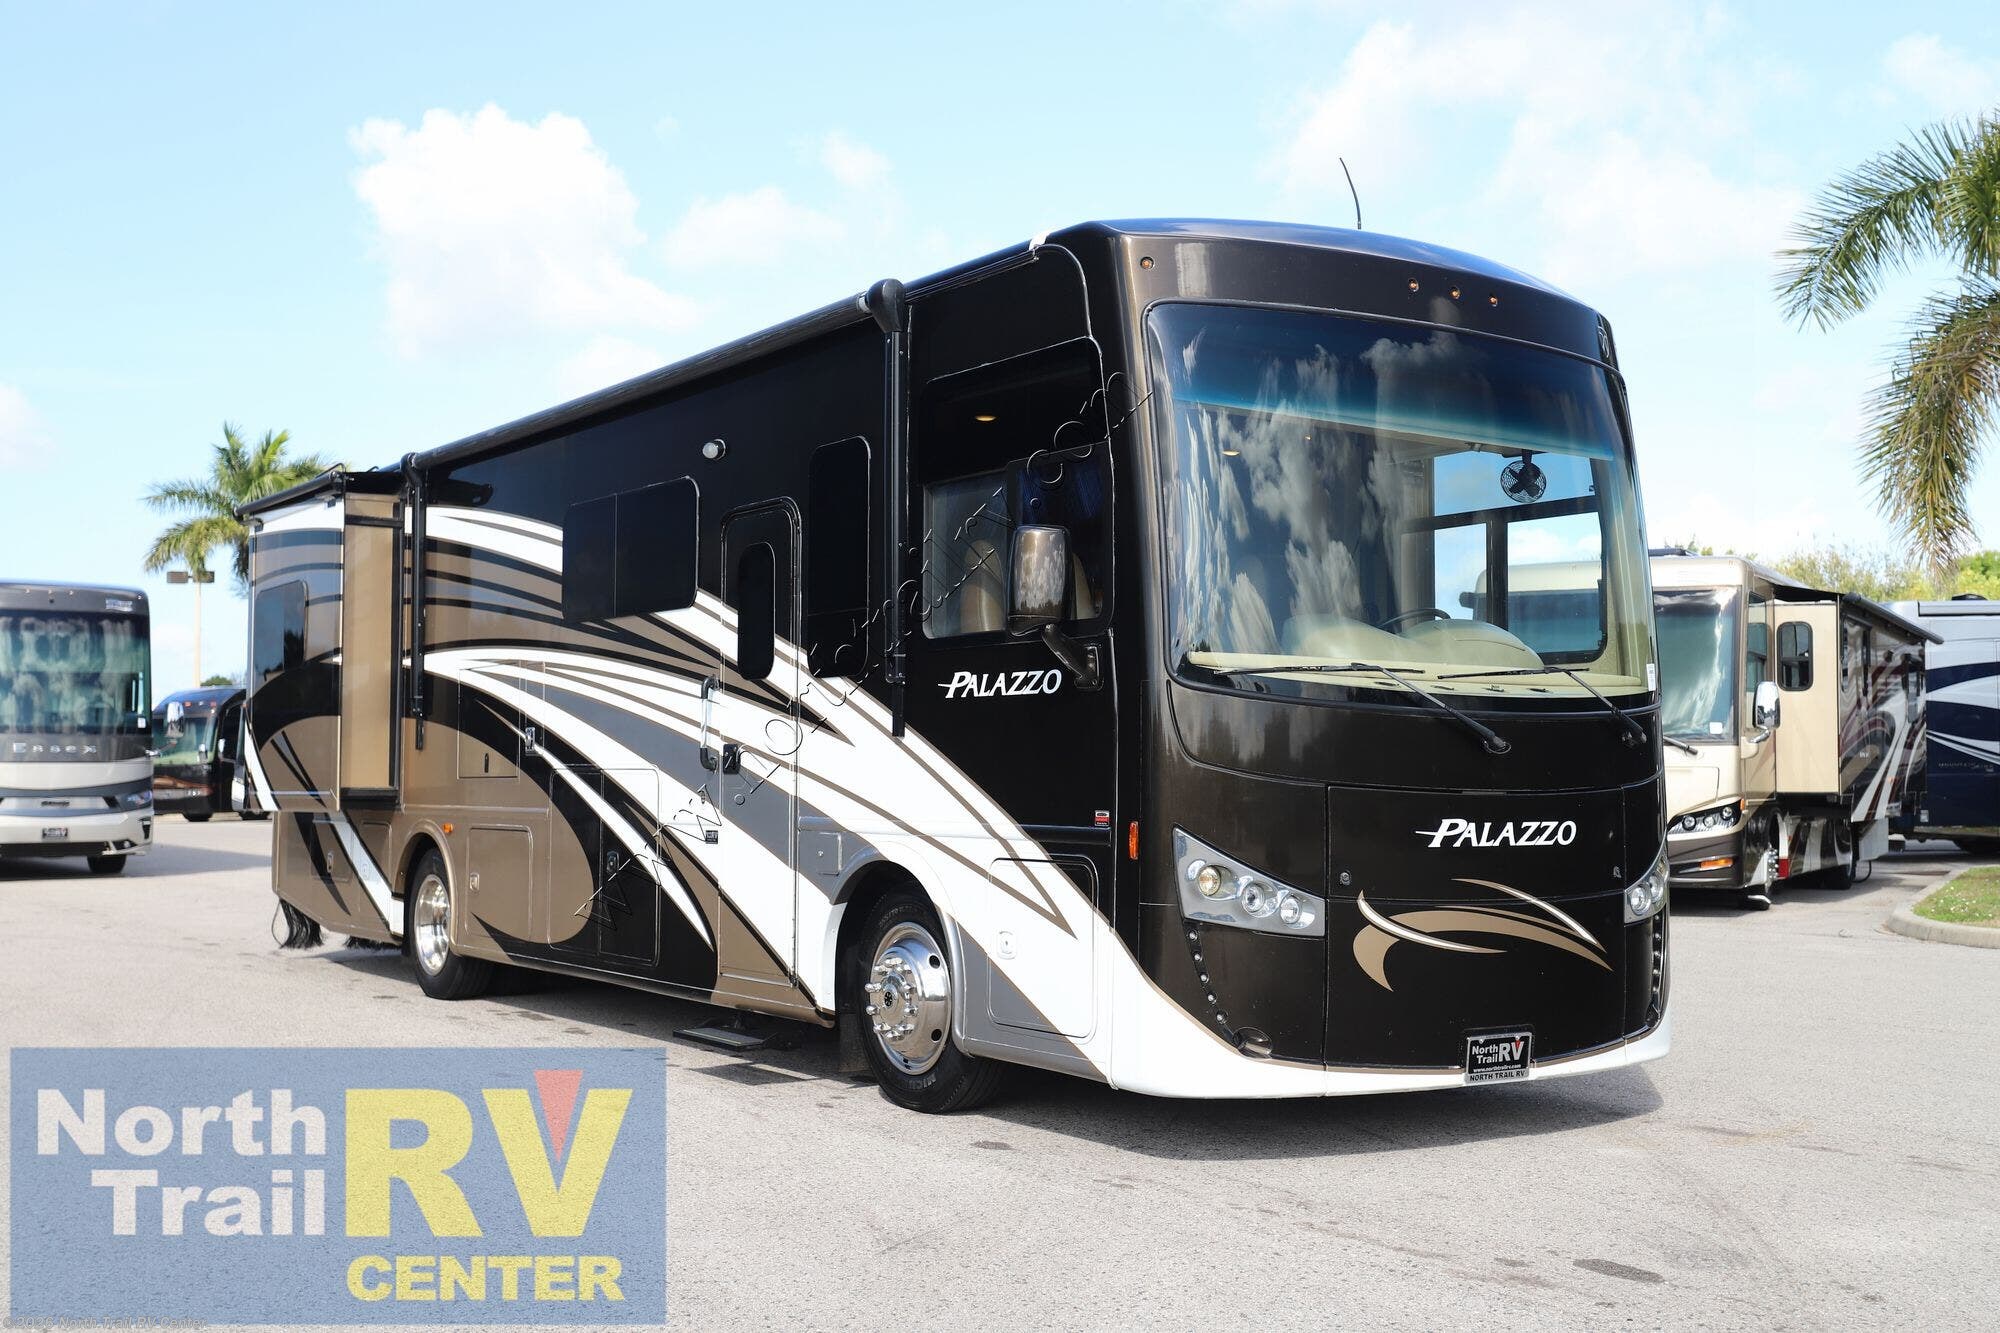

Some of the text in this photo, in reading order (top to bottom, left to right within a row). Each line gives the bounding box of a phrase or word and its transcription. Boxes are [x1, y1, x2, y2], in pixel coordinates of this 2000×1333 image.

[938, 669, 1062, 698] PALAZZO
[1415, 818, 1577, 848] PALAZZO
[1472, 1044, 1498, 1055] North
[1499, 1041, 1524, 1062] RV
[1477, 1054, 1498, 1064] Trail
[1470, 1073, 1494, 1081] NORTH
